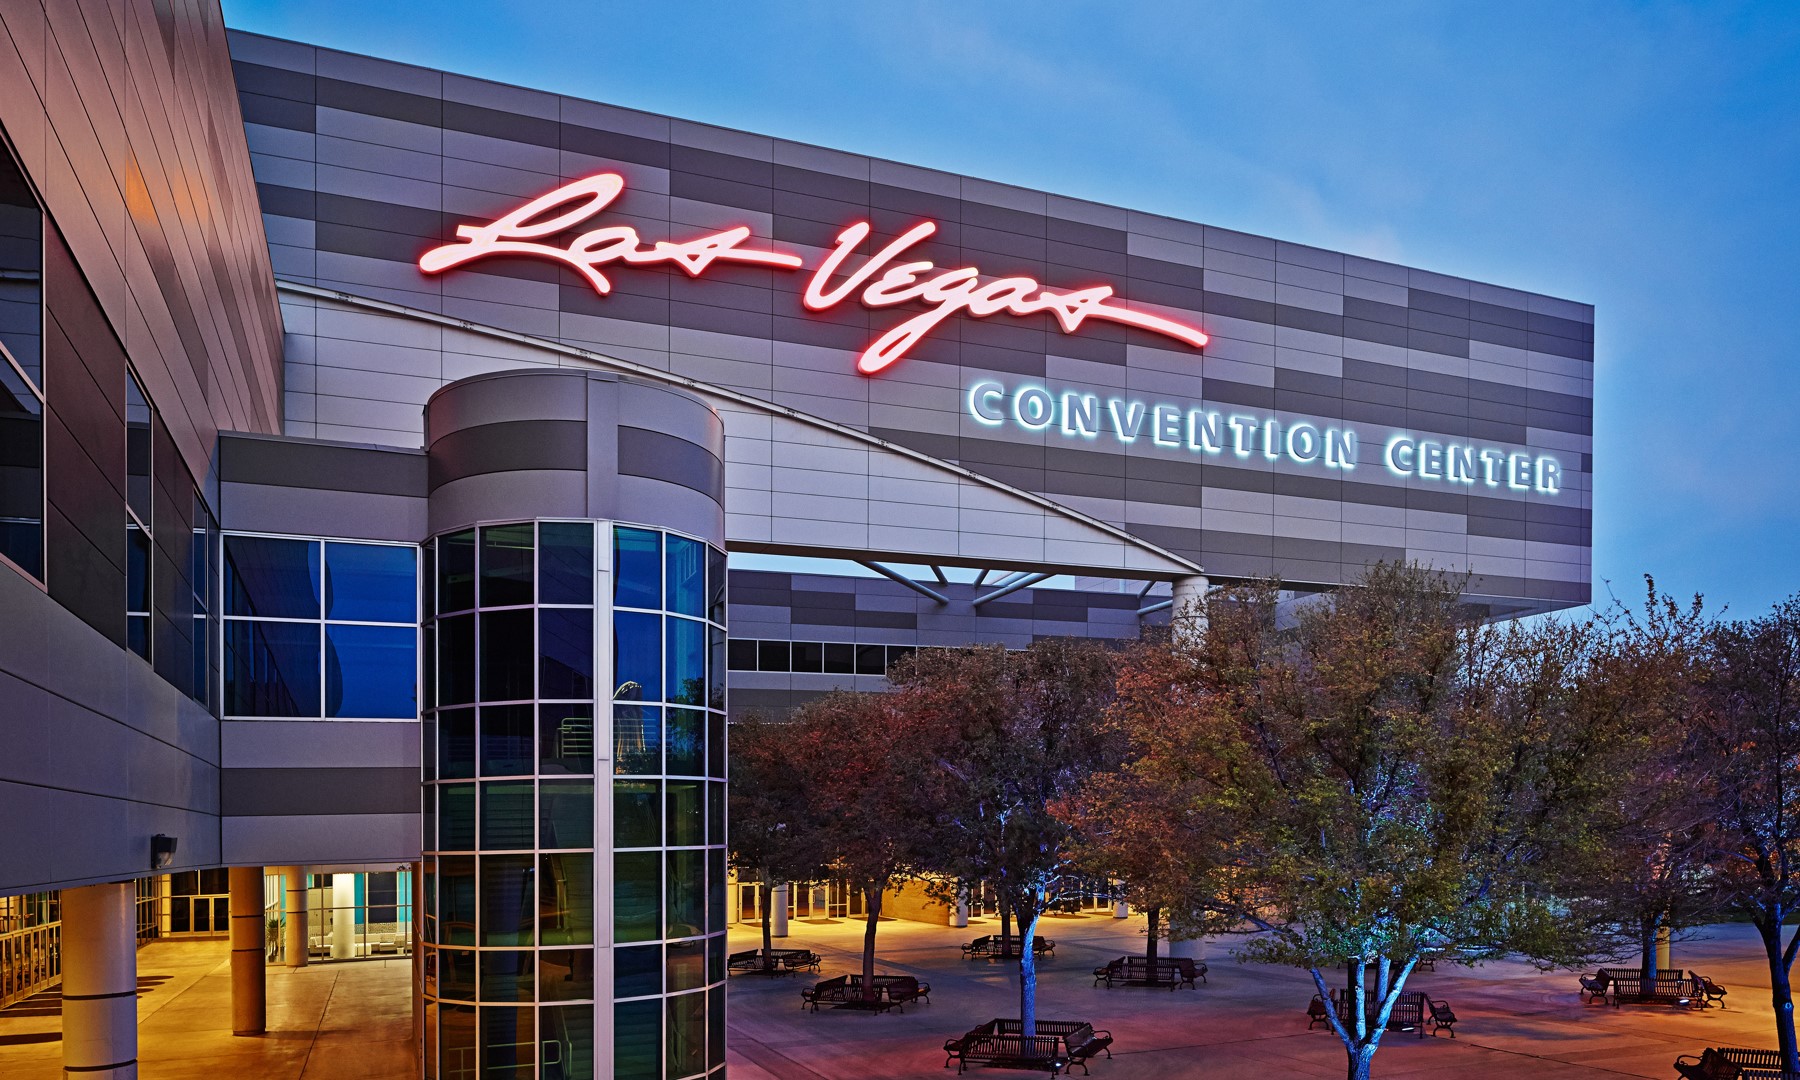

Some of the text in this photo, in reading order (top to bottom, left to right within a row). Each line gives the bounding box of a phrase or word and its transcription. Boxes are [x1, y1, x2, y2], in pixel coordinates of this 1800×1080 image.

[419, 173, 1208, 375] Las Vegas
[970, 381, 1562, 493] CONVENTION CENTER
